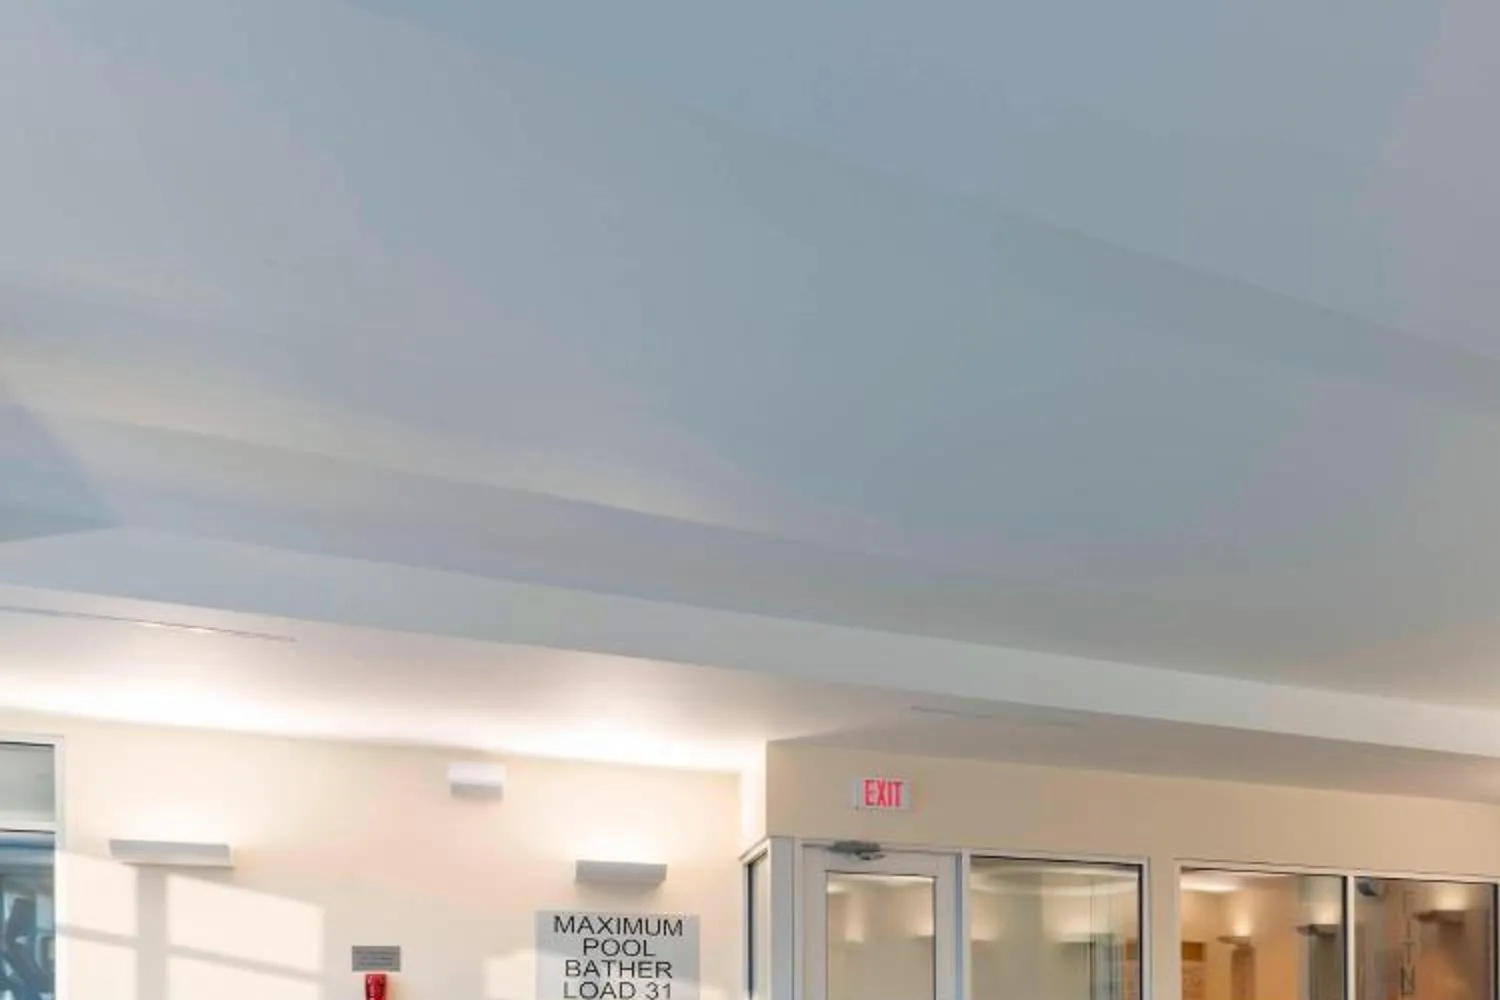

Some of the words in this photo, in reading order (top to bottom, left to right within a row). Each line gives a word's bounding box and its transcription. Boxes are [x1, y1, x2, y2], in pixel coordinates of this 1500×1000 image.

[864, 779, 904, 807] EXIT
[553, 915, 684, 937] MAXIMUM
[583, 937, 656, 957] POOL
[565, 959, 673, 979] BATHER
[563, 981, 637, 1000] LOAD
[645, 981, 672, 1000] 31
